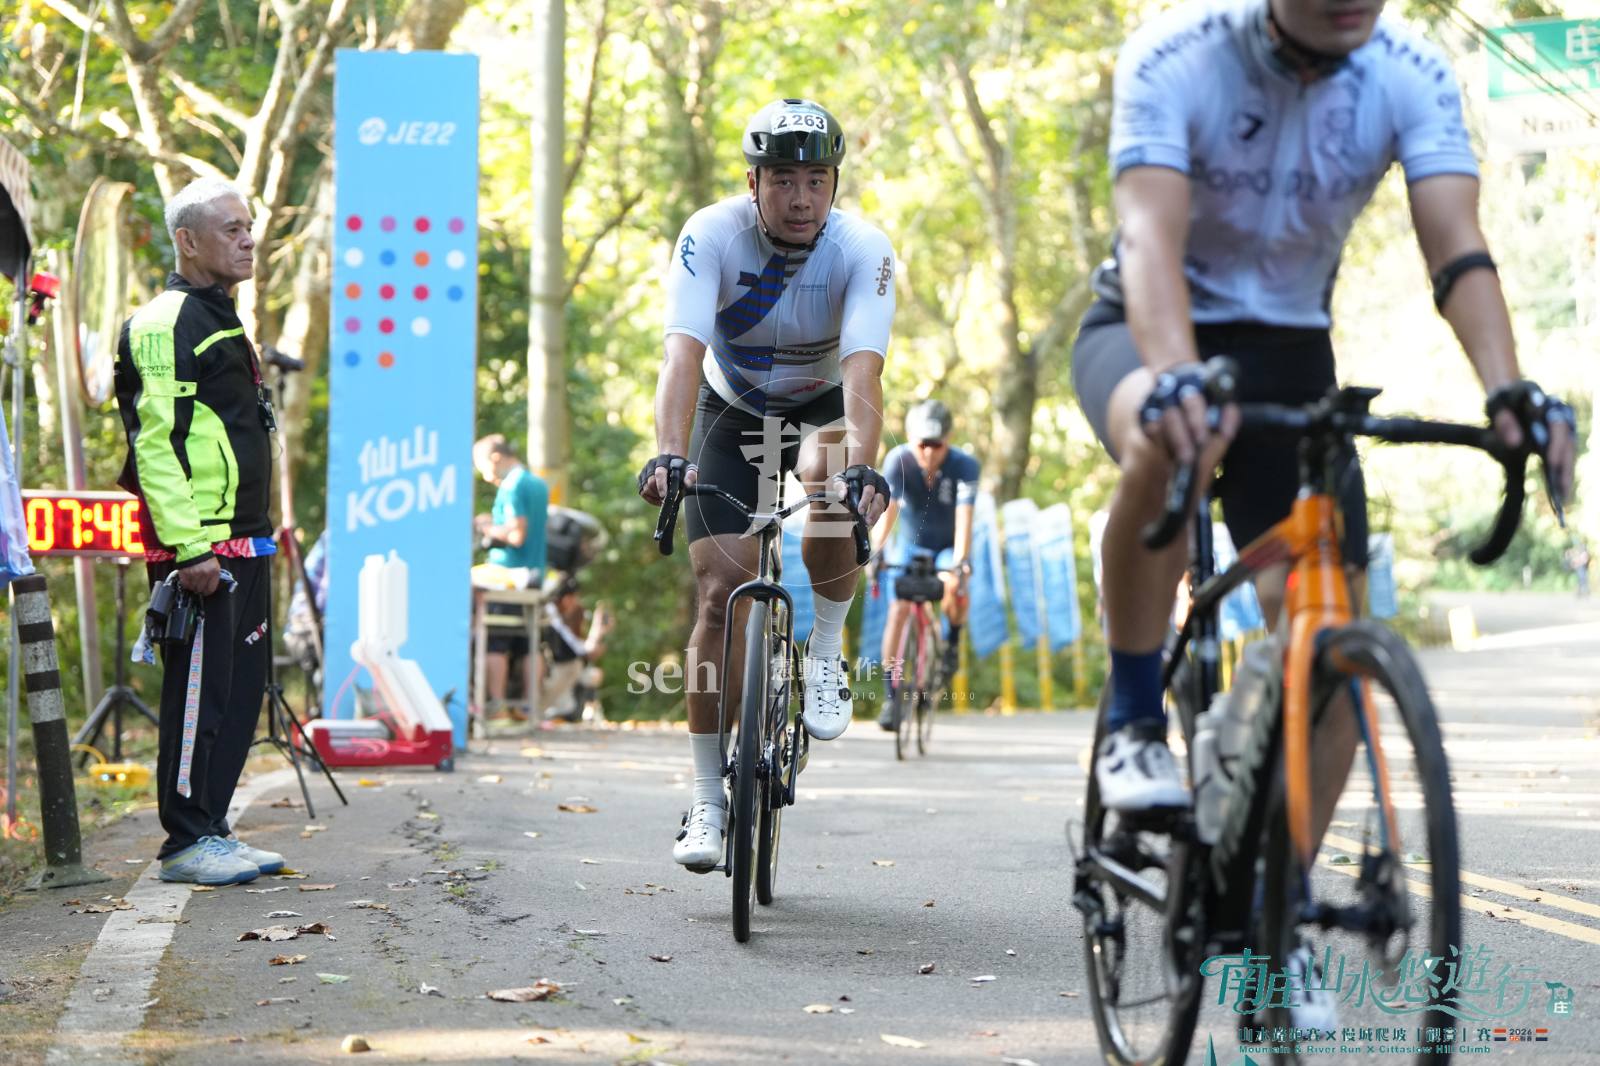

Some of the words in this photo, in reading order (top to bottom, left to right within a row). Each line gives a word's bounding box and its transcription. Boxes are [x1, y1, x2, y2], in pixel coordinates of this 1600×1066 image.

[386, 120, 457, 145] JE22
[358, 425, 439, 485] 仙山
[345, 463, 457, 532] KOM
